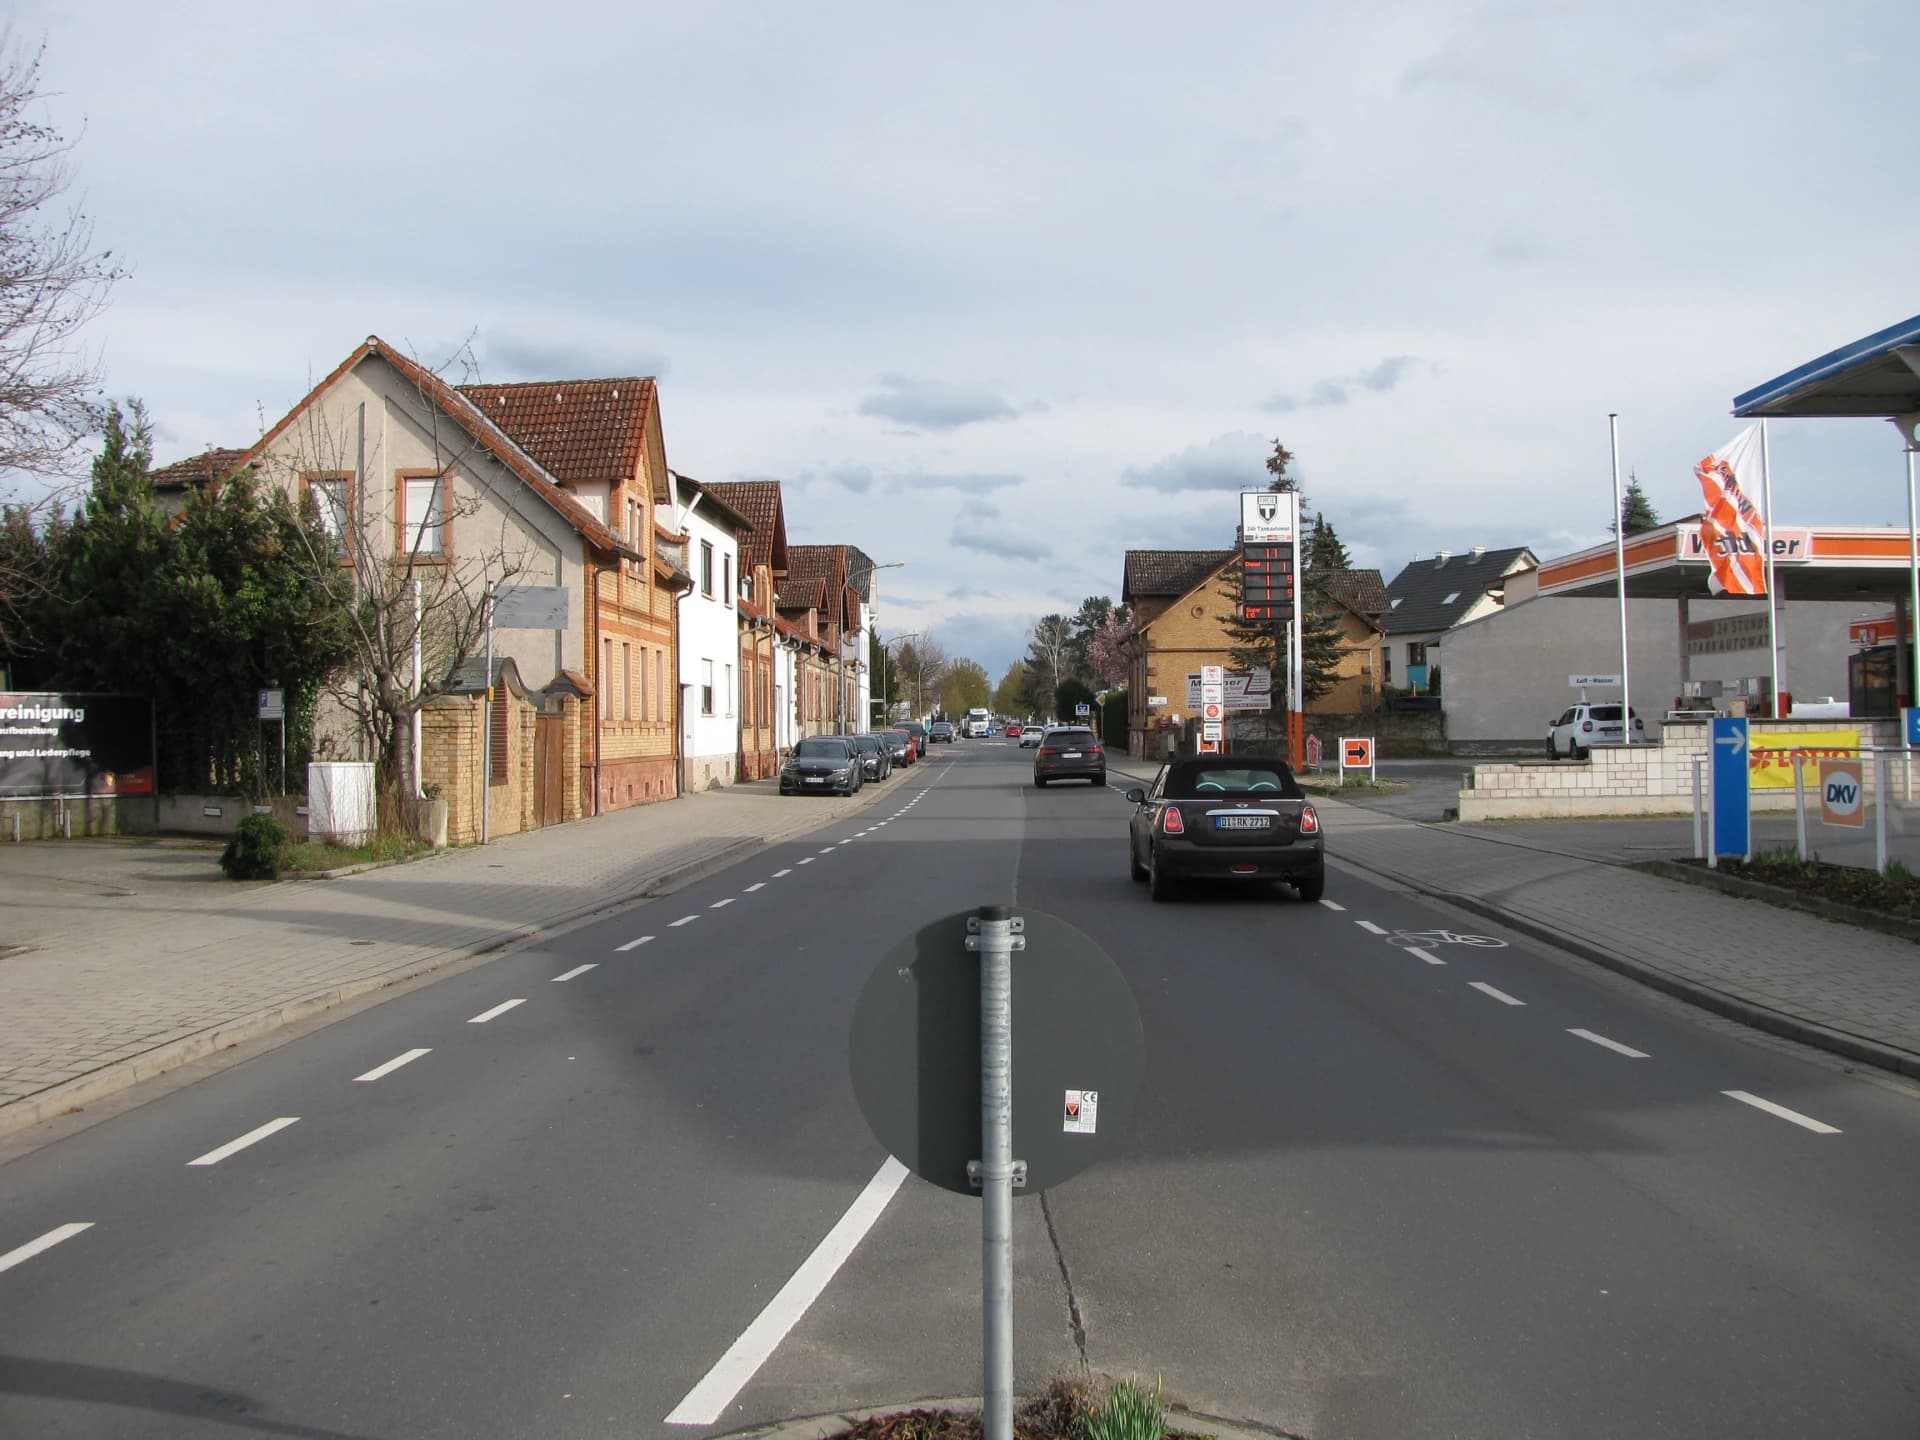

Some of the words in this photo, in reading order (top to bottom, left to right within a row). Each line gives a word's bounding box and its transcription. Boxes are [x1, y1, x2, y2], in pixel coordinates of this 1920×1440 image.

[16, 748, 35, 757] und
[36, 748, 91, 758] Lederpflege
[1826, 783, 1857, 804] DKV
[1082, 1092, 1097, 1103] CE
